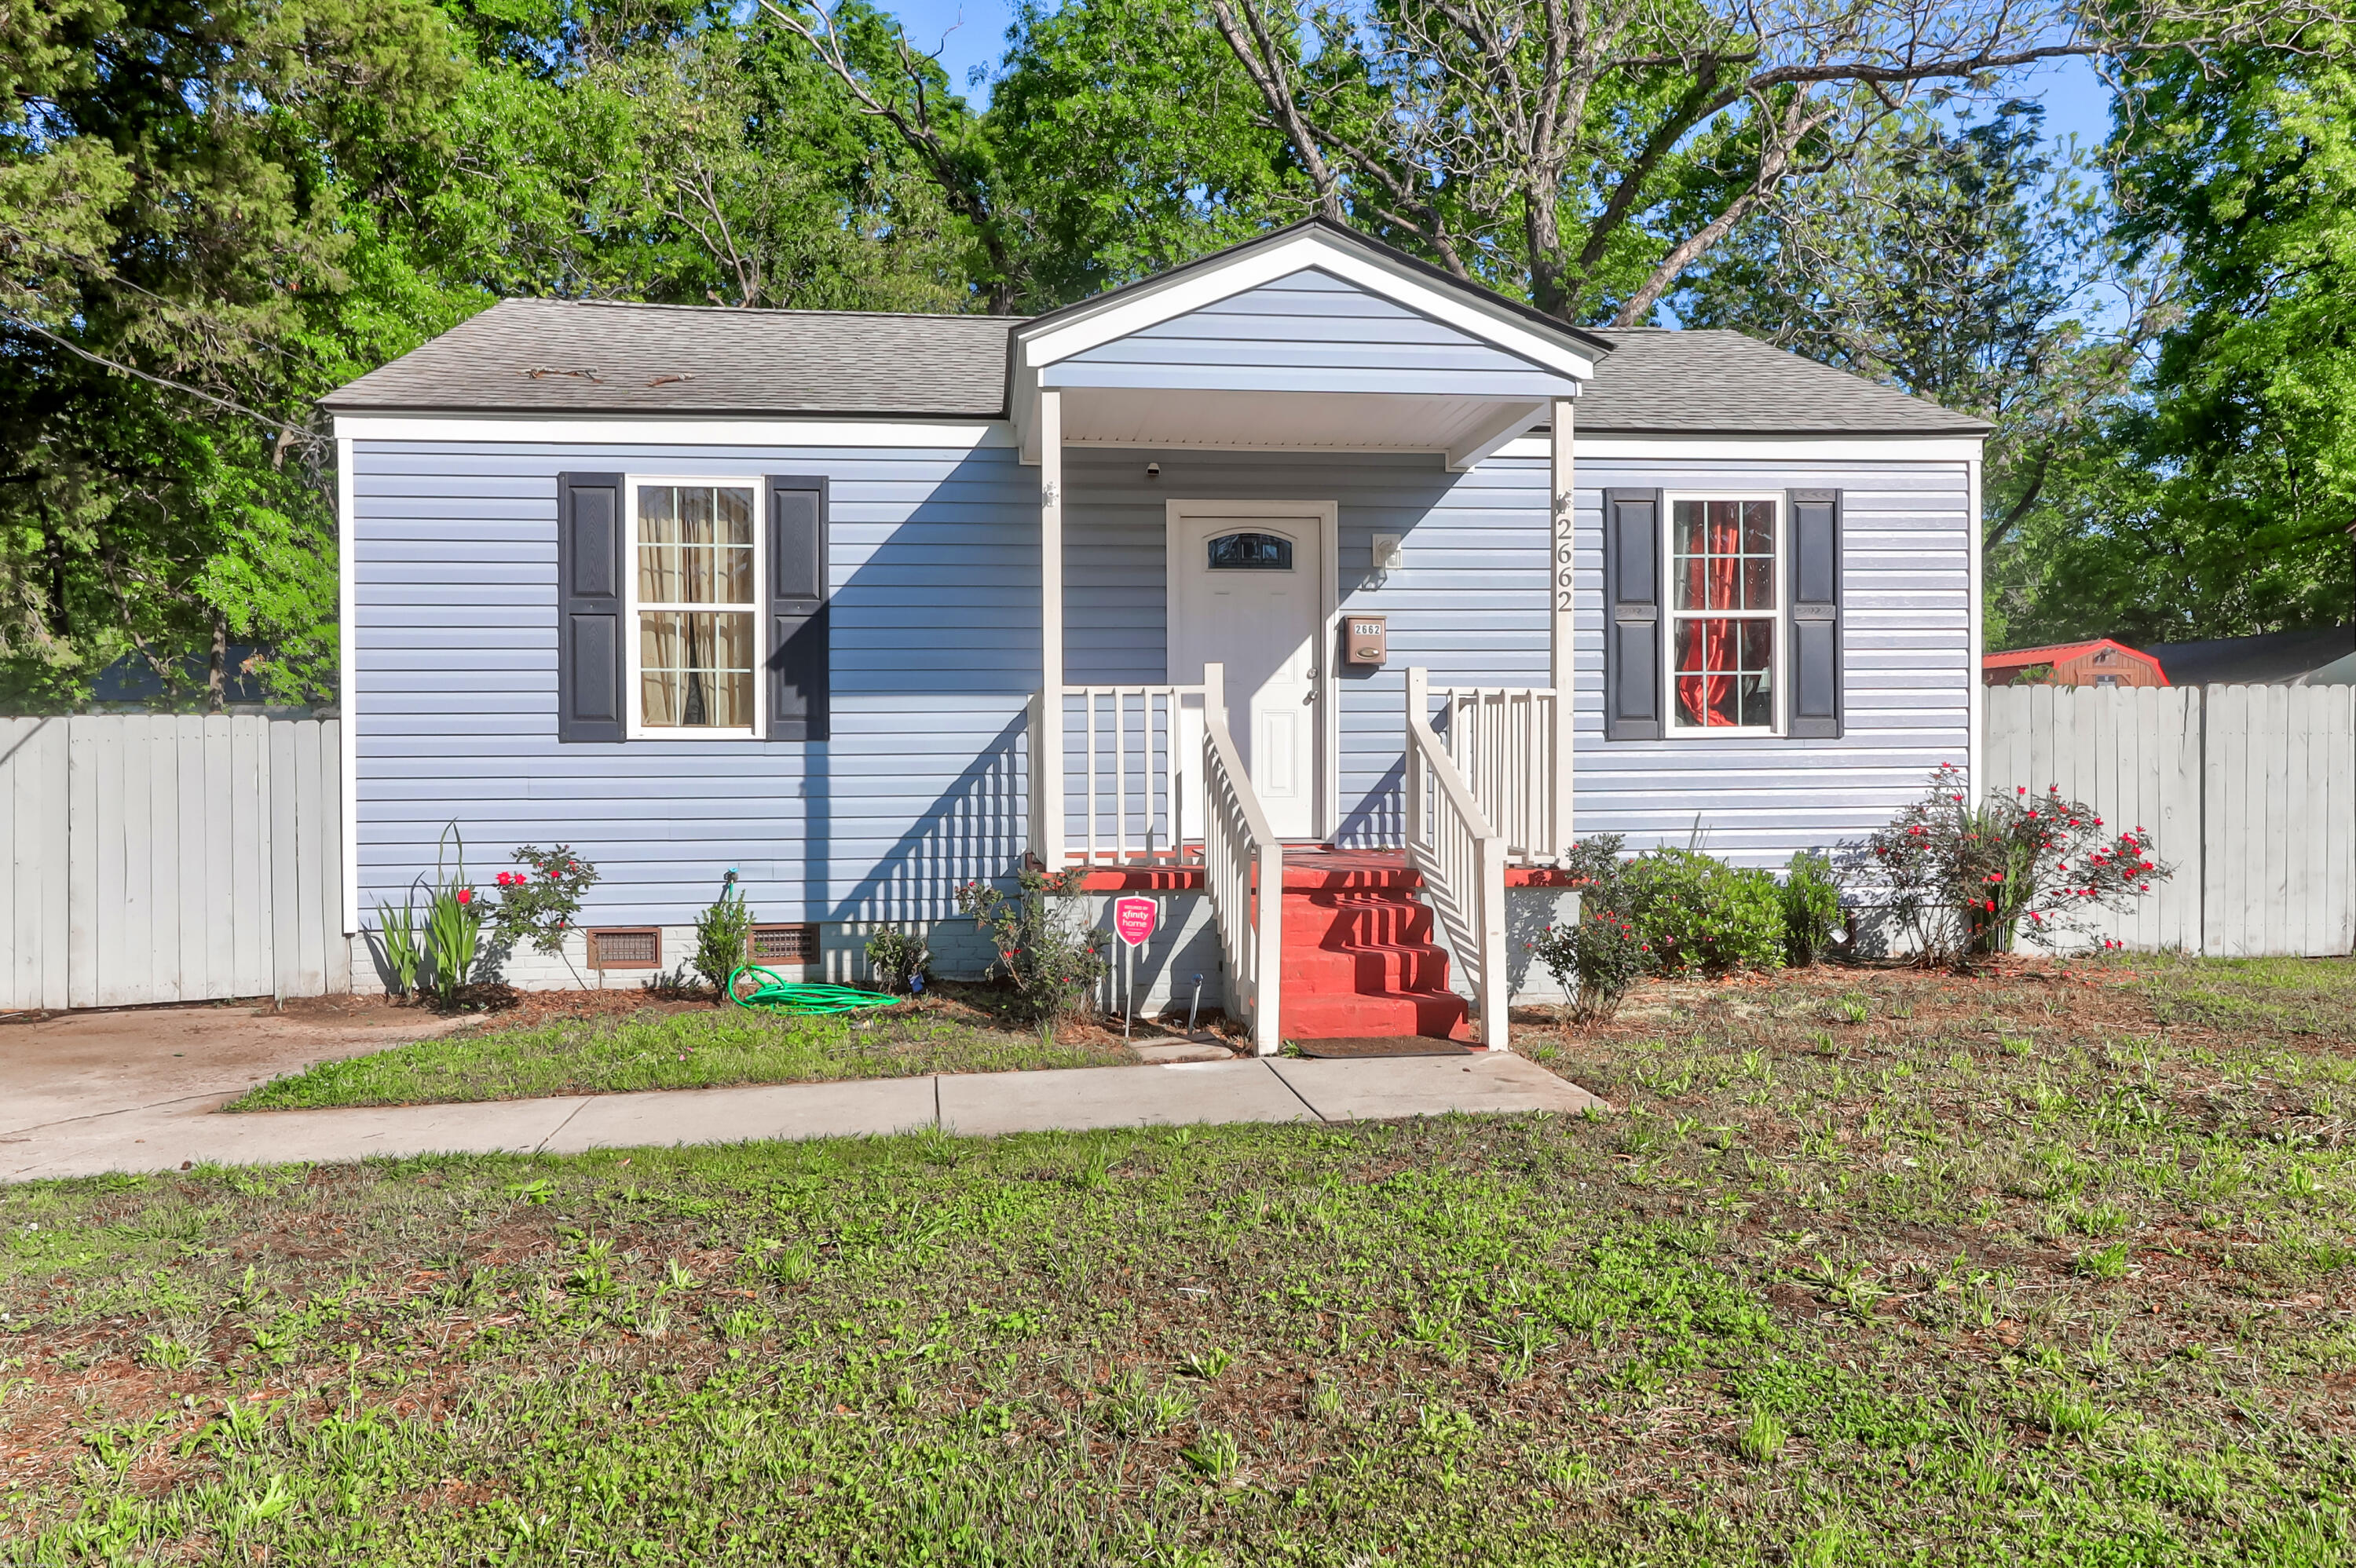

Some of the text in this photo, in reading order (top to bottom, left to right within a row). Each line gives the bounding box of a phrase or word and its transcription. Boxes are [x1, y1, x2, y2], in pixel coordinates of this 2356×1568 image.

[1557, 519, 1572, 612] 2662
[1355, 625, 1380, 634] 2662
[1122, 910, 1149, 920] xfinity
[1122, 919, 1147, 927] home
